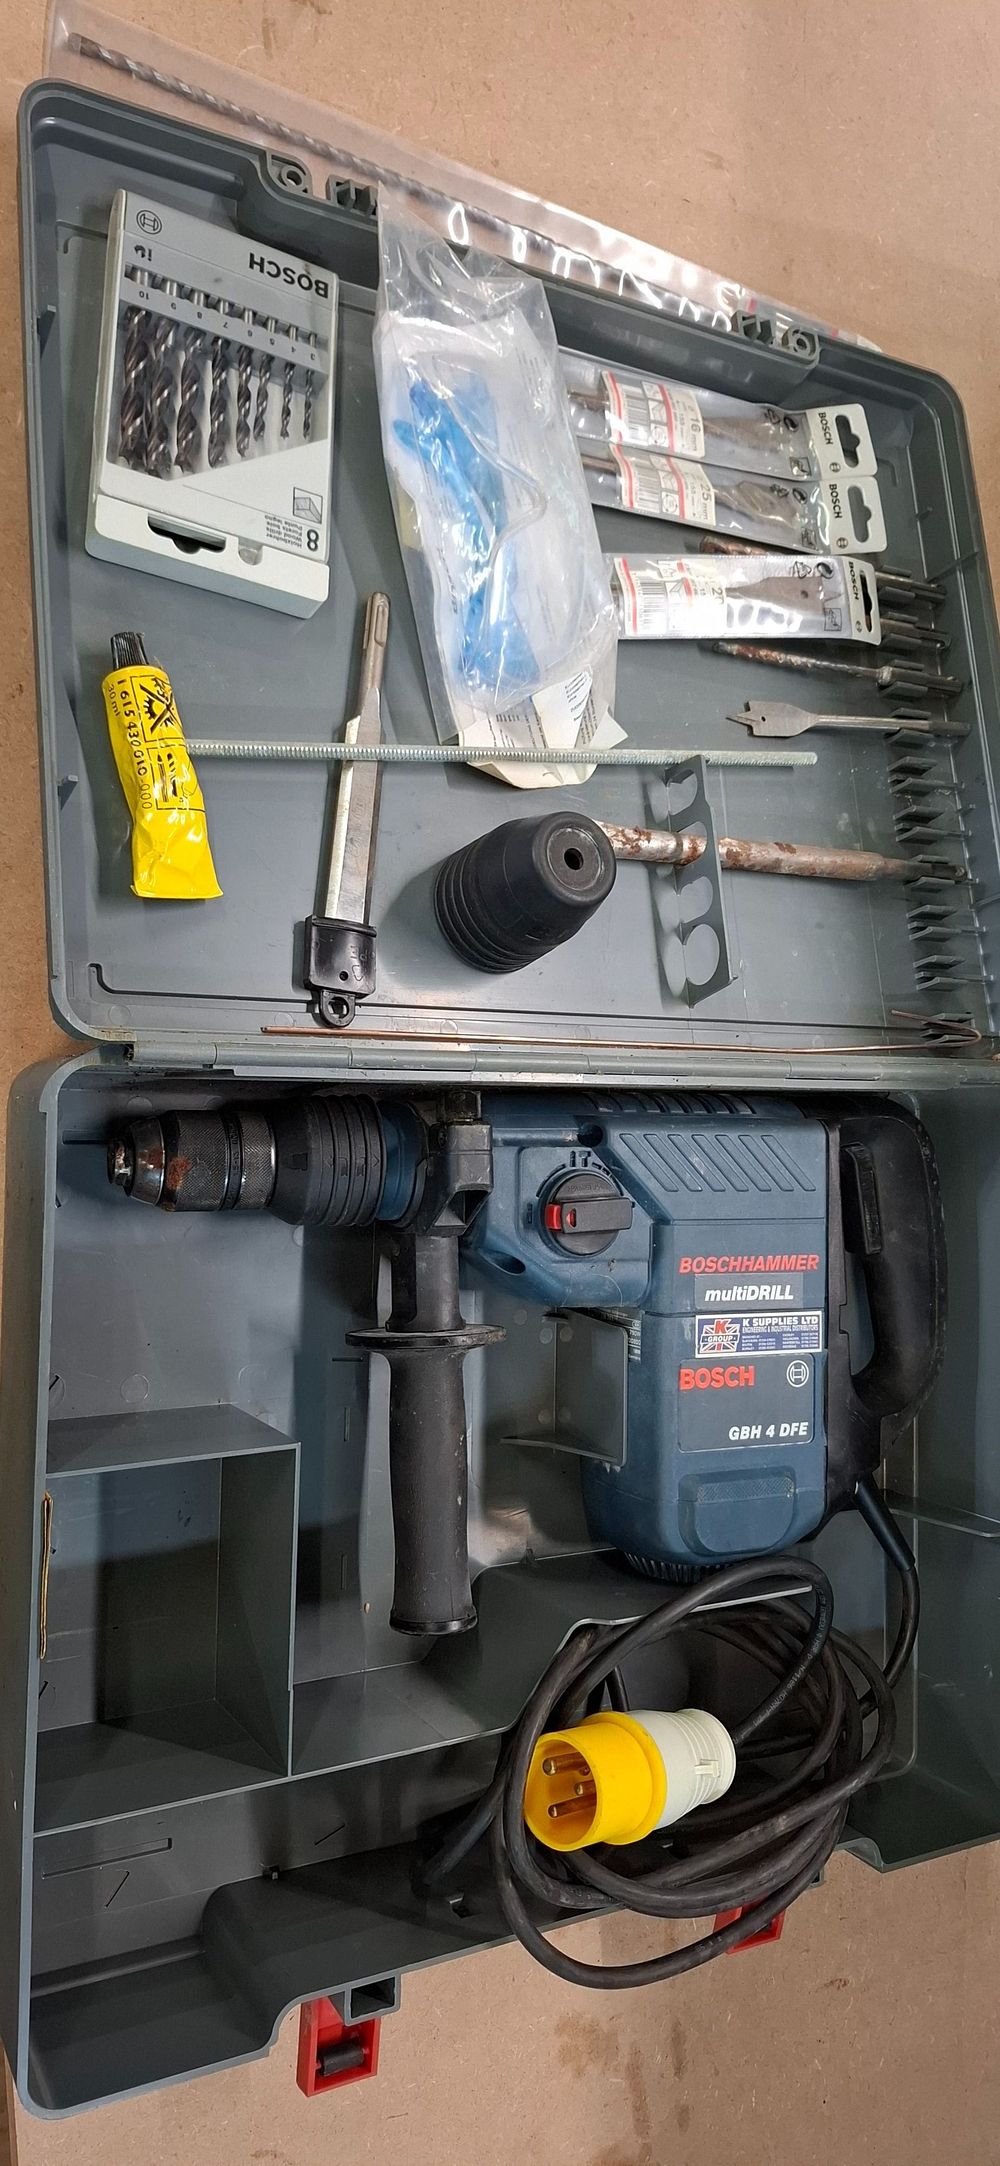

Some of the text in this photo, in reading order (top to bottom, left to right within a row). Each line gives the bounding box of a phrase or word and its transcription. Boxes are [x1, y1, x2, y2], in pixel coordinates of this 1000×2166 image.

[248, 252, 329, 299] BOSCH
[818, 412, 834, 446] BOSCH
[700, 484, 712, 501] 25
[829, 484, 843, 519] BOSCH
[306, 529, 319, 552] 8
[848, 561, 860, 600] BOSCH
[108, 684, 121, 717] 30 ml
[120, 690, 136, 718] 615
[127, 721, 142, 747] 430
[679, 1254, 820, 1274] BOSCHHAMMER
[704, 1284, 795, 1302] multiDRILL
[714, 1318, 733, 1335] K
[742, 1315, 819, 1327] K SUPPLIES LTD
[707, 1335, 733, 1343] GROUP
[680, 1365, 756, 1391] BOSCH
[728, 1421, 809, 1441] GBH 4 DFE
